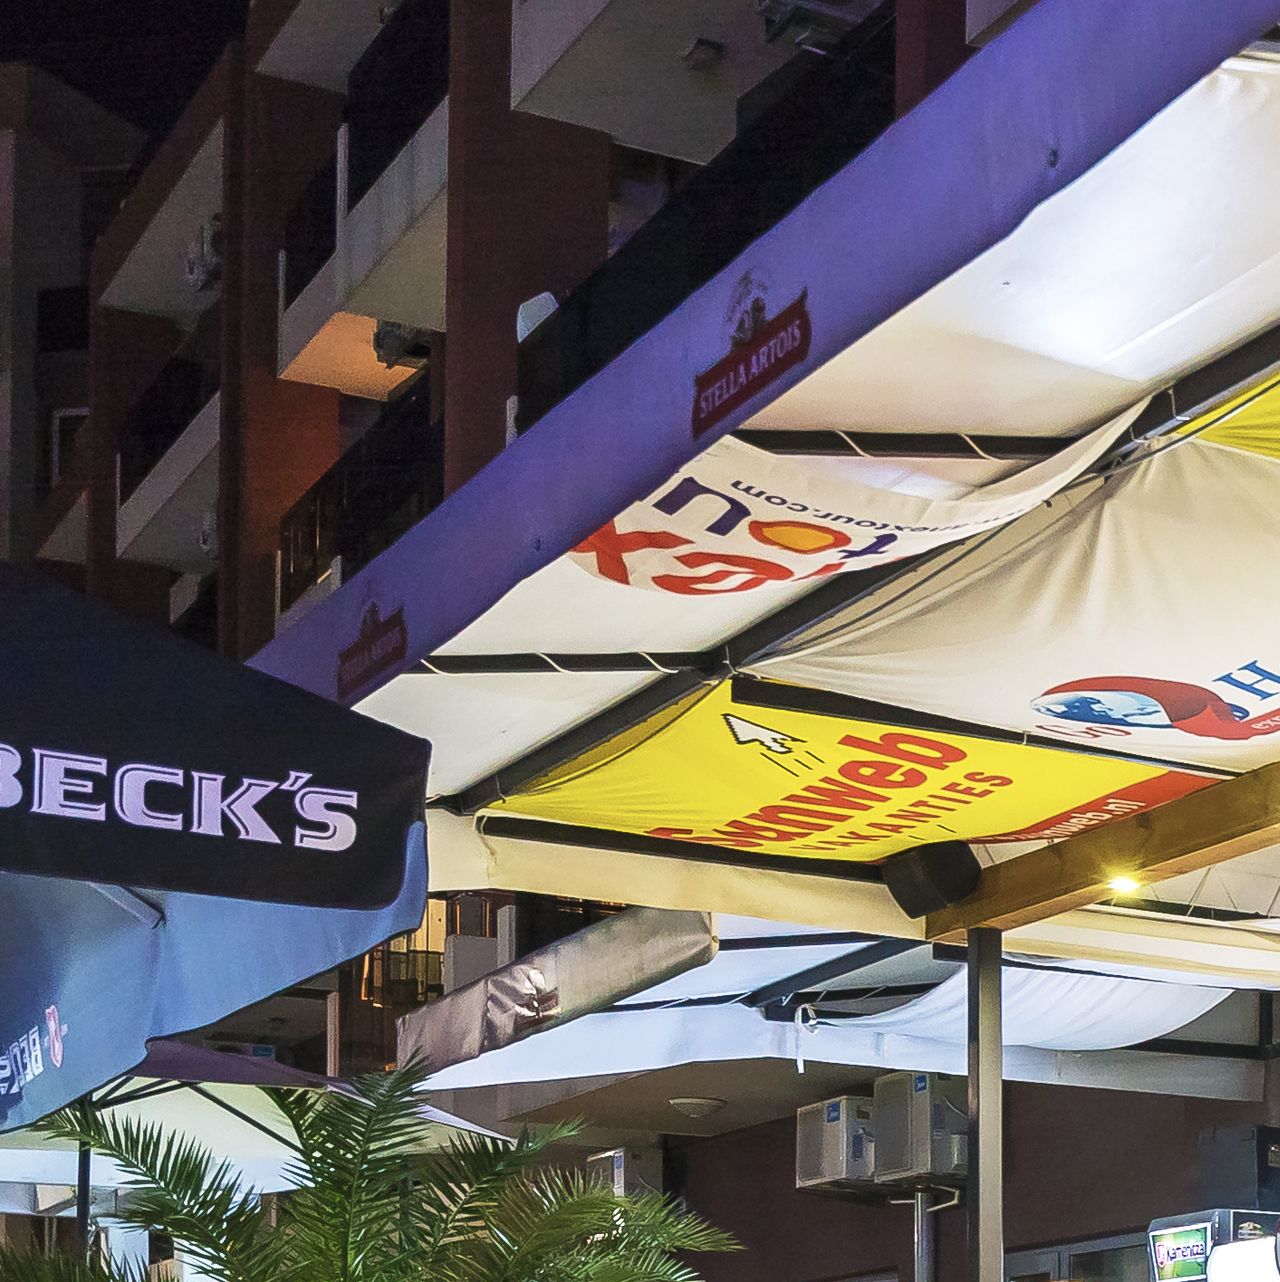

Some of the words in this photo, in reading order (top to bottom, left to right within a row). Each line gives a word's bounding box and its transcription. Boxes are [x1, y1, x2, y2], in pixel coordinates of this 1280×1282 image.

[700, 362, 747, 418] STELLA
[750, 319, 801, 378] ARTOIS
[651, 476, 898, 560] tou
[789, 771, 1015, 852] VAKANTIES
[1166, 1240, 1206, 1262] Kamenitza
